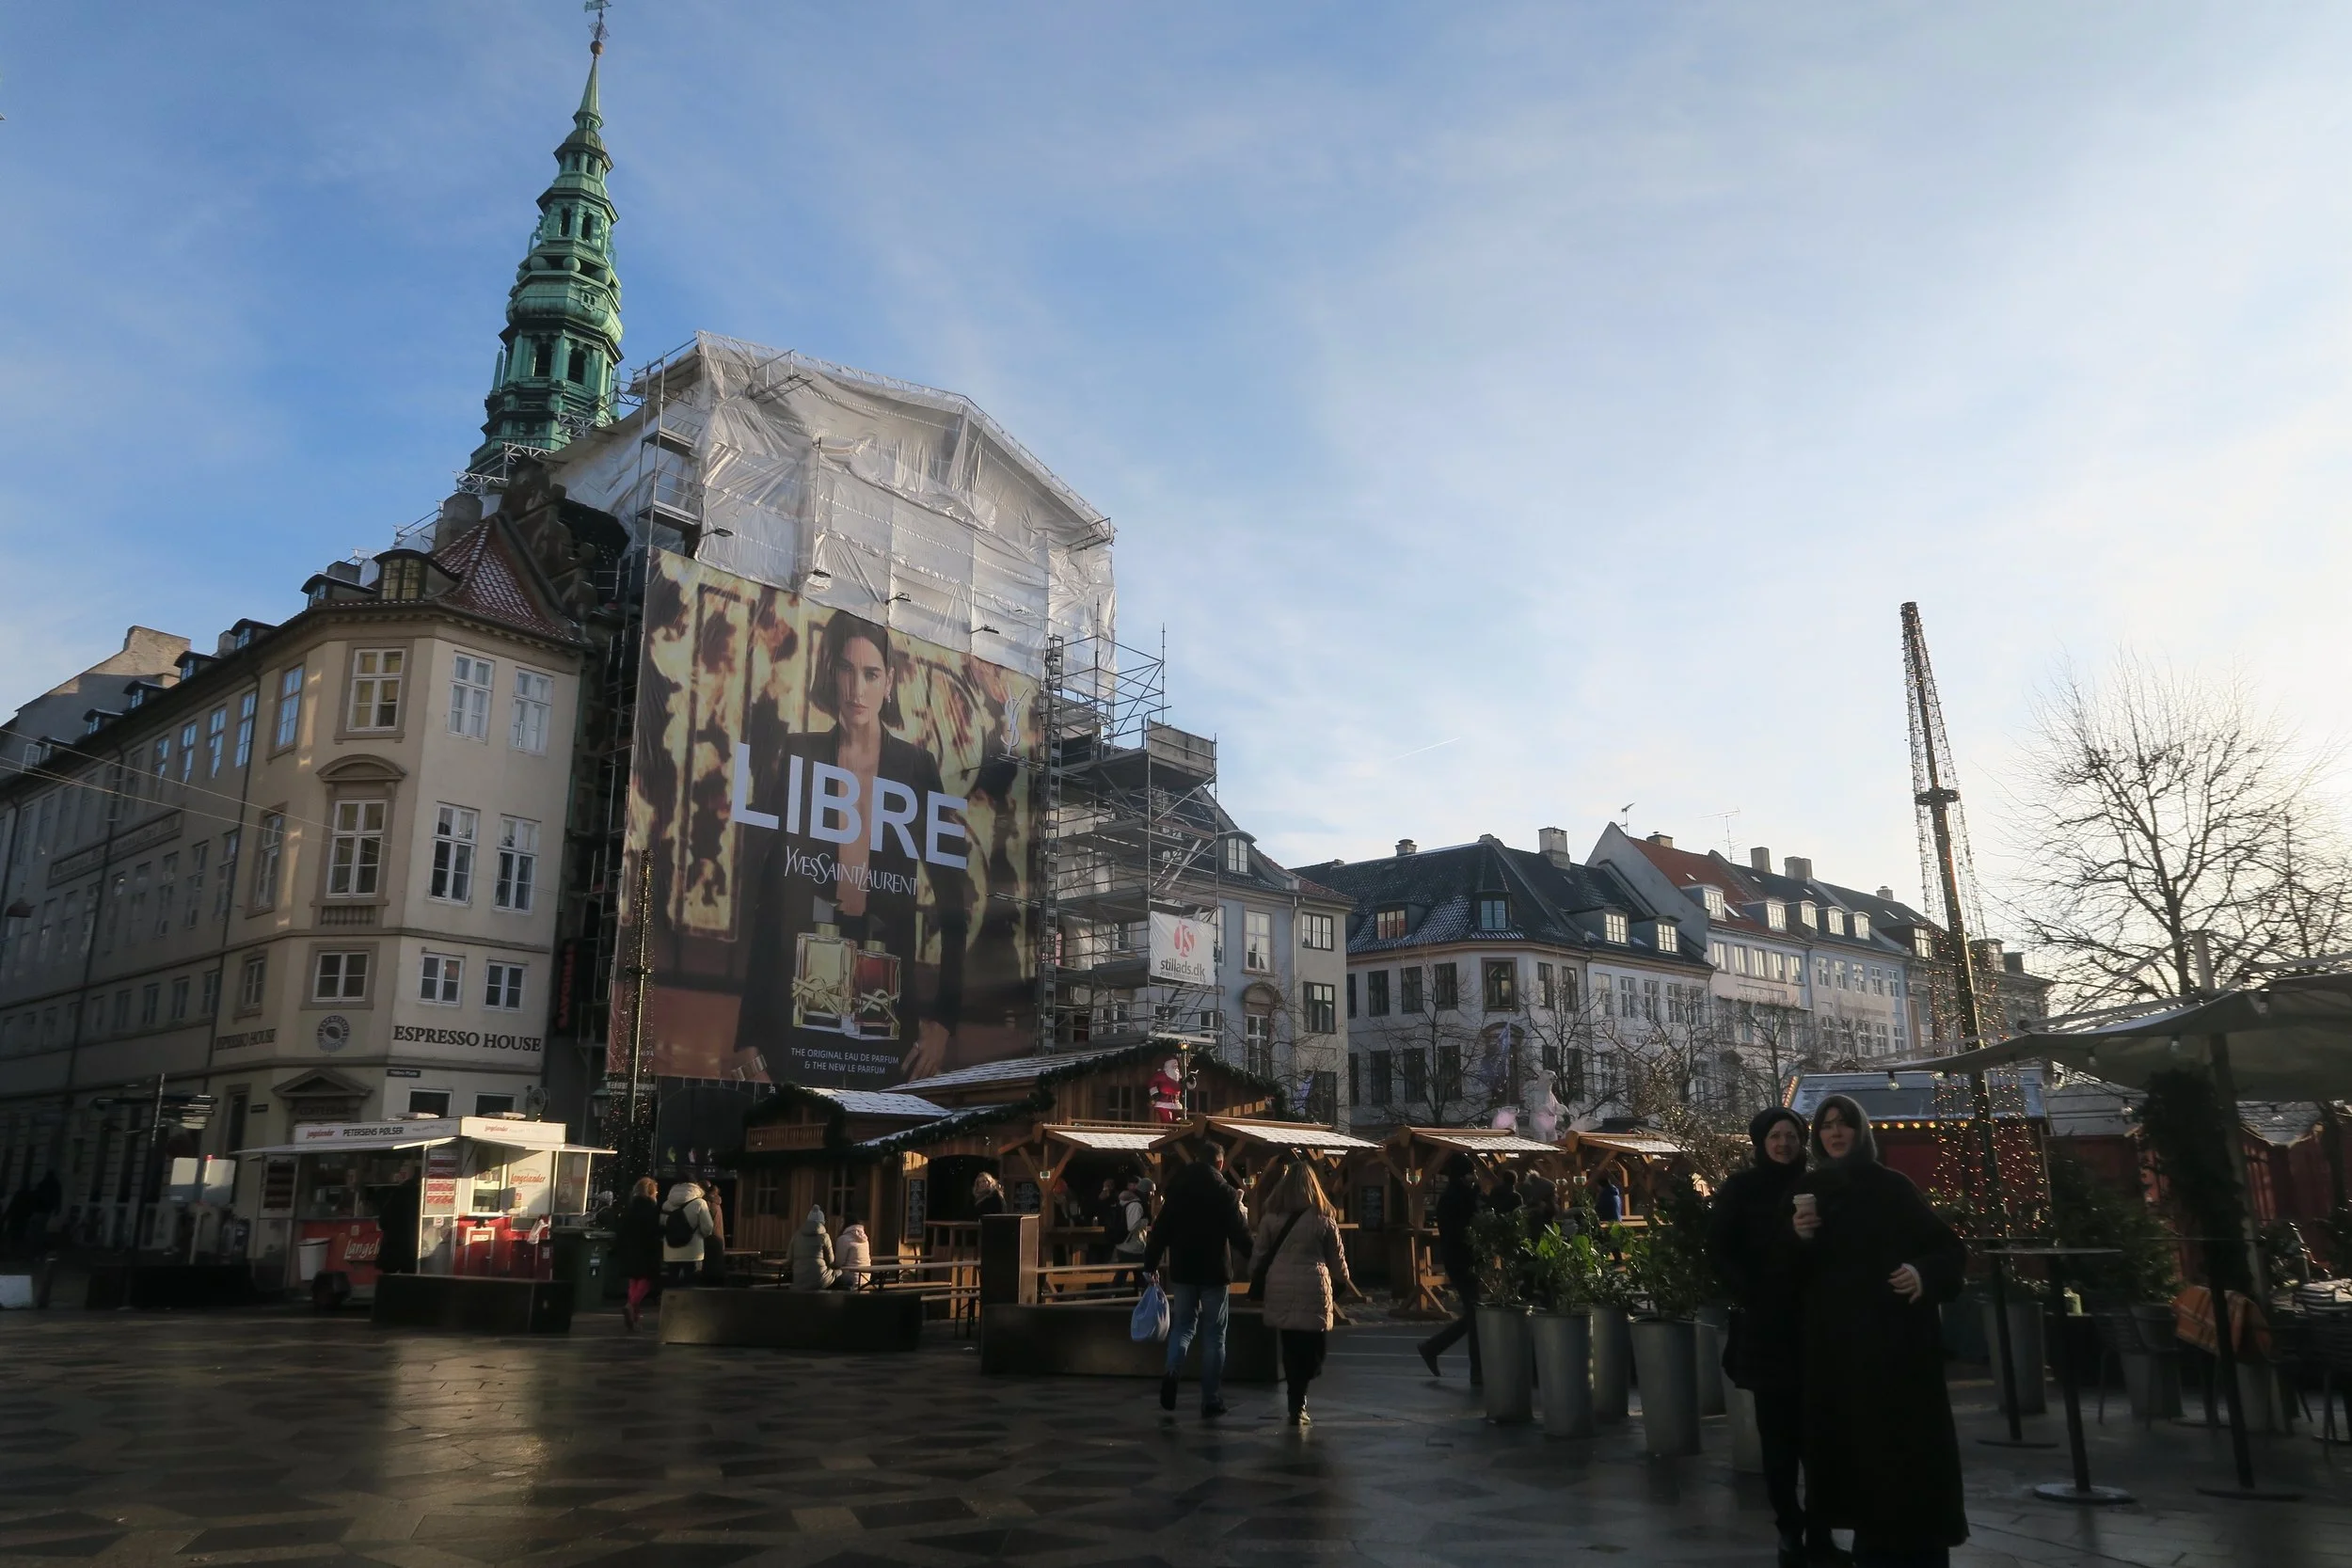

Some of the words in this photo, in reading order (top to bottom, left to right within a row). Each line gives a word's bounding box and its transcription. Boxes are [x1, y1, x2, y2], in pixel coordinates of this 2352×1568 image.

[731, 741, 968, 870] LIBRE
[1160, 958, 1205, 976] stillads.dk
[393, 1025, 480, 1047] ESPRESSO
[483, 1033, 542, 1052] HOUSE
[790, 1047, 805, 1056] THE
[807, 1049, 843, 1060] ORIGINAL
[844, 1052, 859, 1062] EAU
[860, 1053, 870, 1062] DE
[871, 1054, 899, 1065] PARFUM
[804, 1060, 811, 1069] &
[813, 1061, 827, 1070] THE
[828, 1063, 846, 1071] NEW
[848, 1064, 856, 1072] LE
[857, 1064, 885, 1074] PARFUM
[342, 1127, 377, 1137] PETERSENS
[378, 1126, 405, 1136] PØLSER
